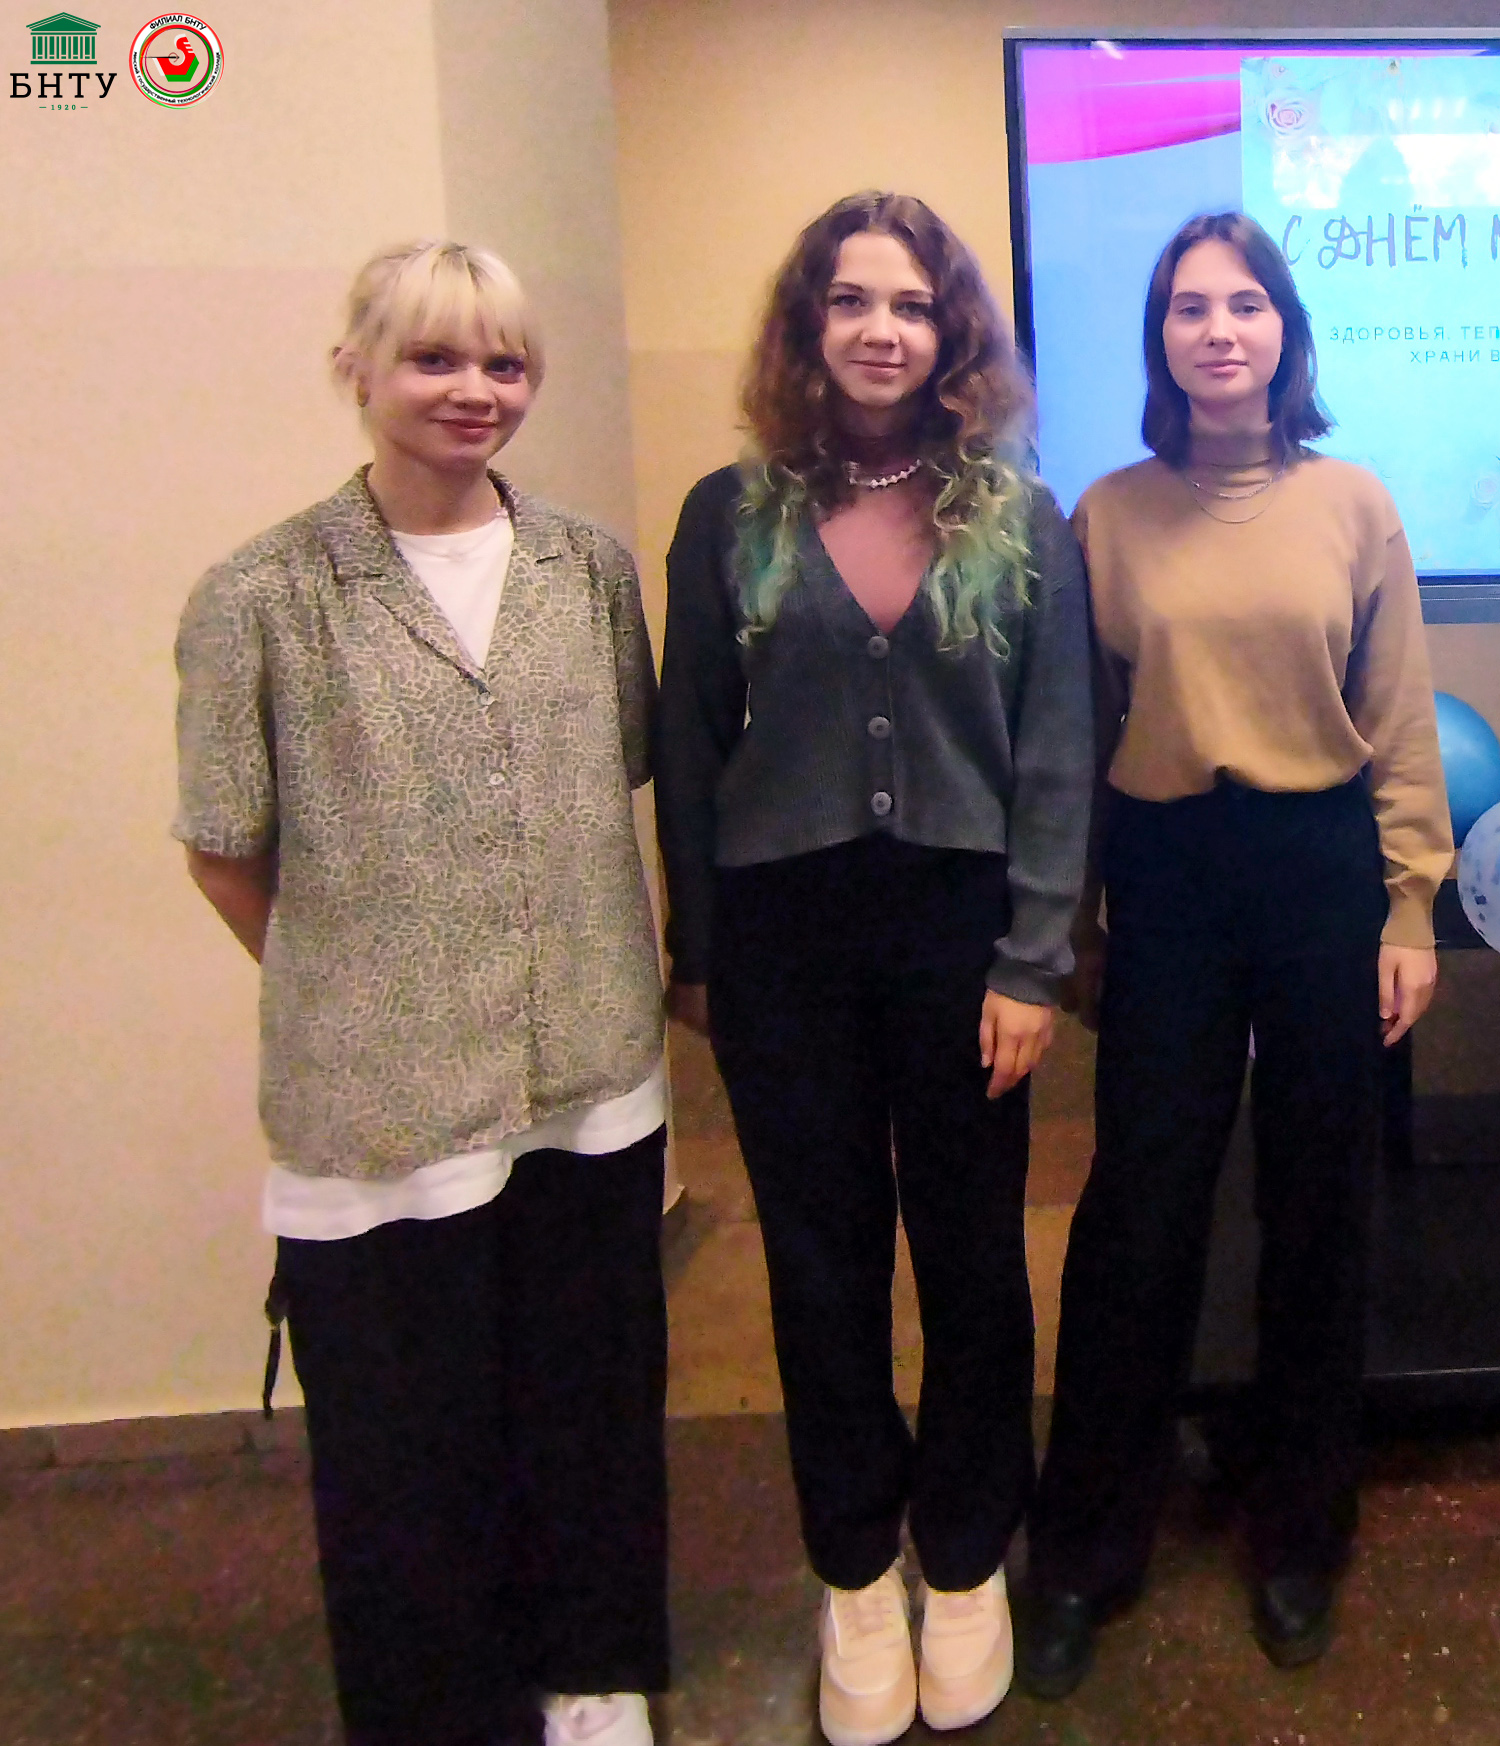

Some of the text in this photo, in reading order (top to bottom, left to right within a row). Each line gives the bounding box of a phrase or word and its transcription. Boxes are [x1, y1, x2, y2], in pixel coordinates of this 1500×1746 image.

[1281, 213, 1310, 267] С
[1317, 203, 1468, 270] ДНЁМ
[1409, 349, 1481, 364] ХРАНИ
